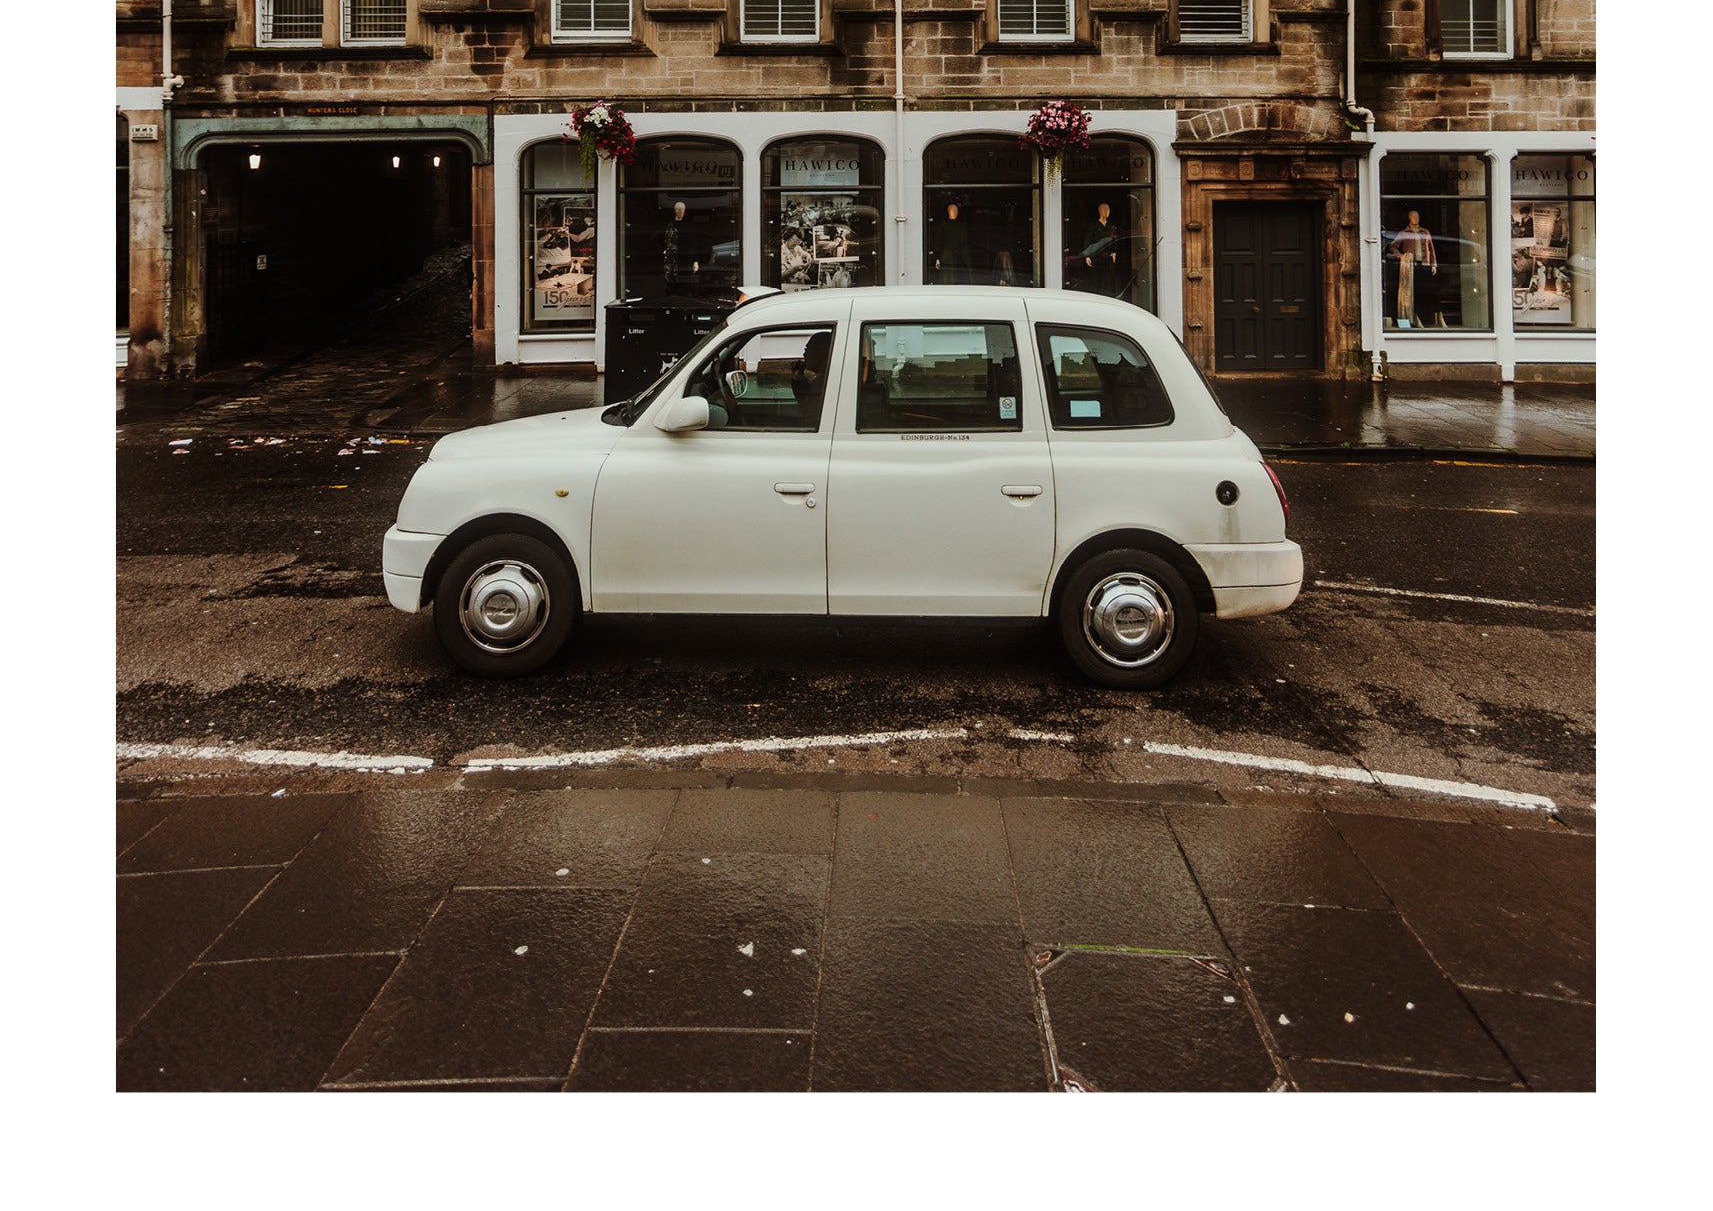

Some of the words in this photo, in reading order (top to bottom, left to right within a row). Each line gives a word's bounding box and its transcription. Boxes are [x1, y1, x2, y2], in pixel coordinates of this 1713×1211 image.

[338, 106, 358, 114] CLOSE
[785, 159, 860, 171] HAWICO
[946, 157, 1019, 169] HAWICO
[1071, 157, 1144, 168] HAWICO
[1397, 170, 1469, 181] HAWICO
[1515, 170, 1588, 181] HAWICO
[543, 290, 569, 305] 150
